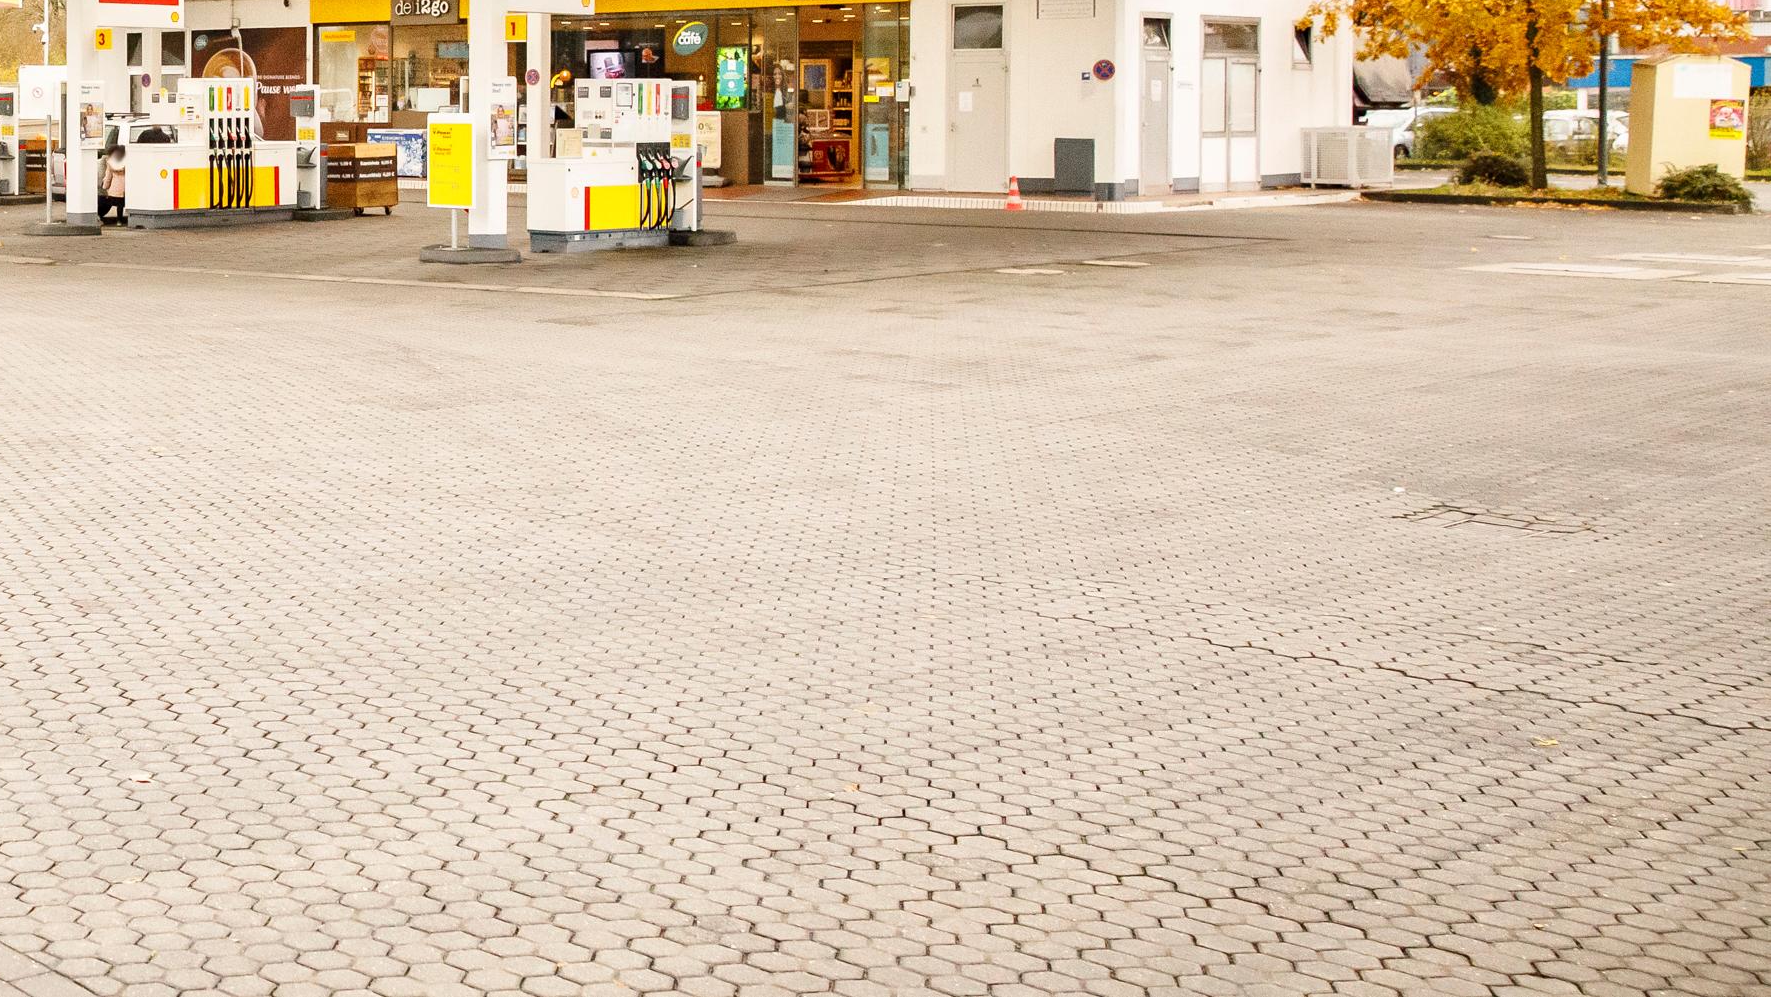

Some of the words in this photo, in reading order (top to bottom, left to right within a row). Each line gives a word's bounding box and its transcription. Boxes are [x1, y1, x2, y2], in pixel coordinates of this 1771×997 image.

[510, 21, 516, 37] 1
[98, 32, 106, 46] 3
[256, 81, 282, 94] Pause
